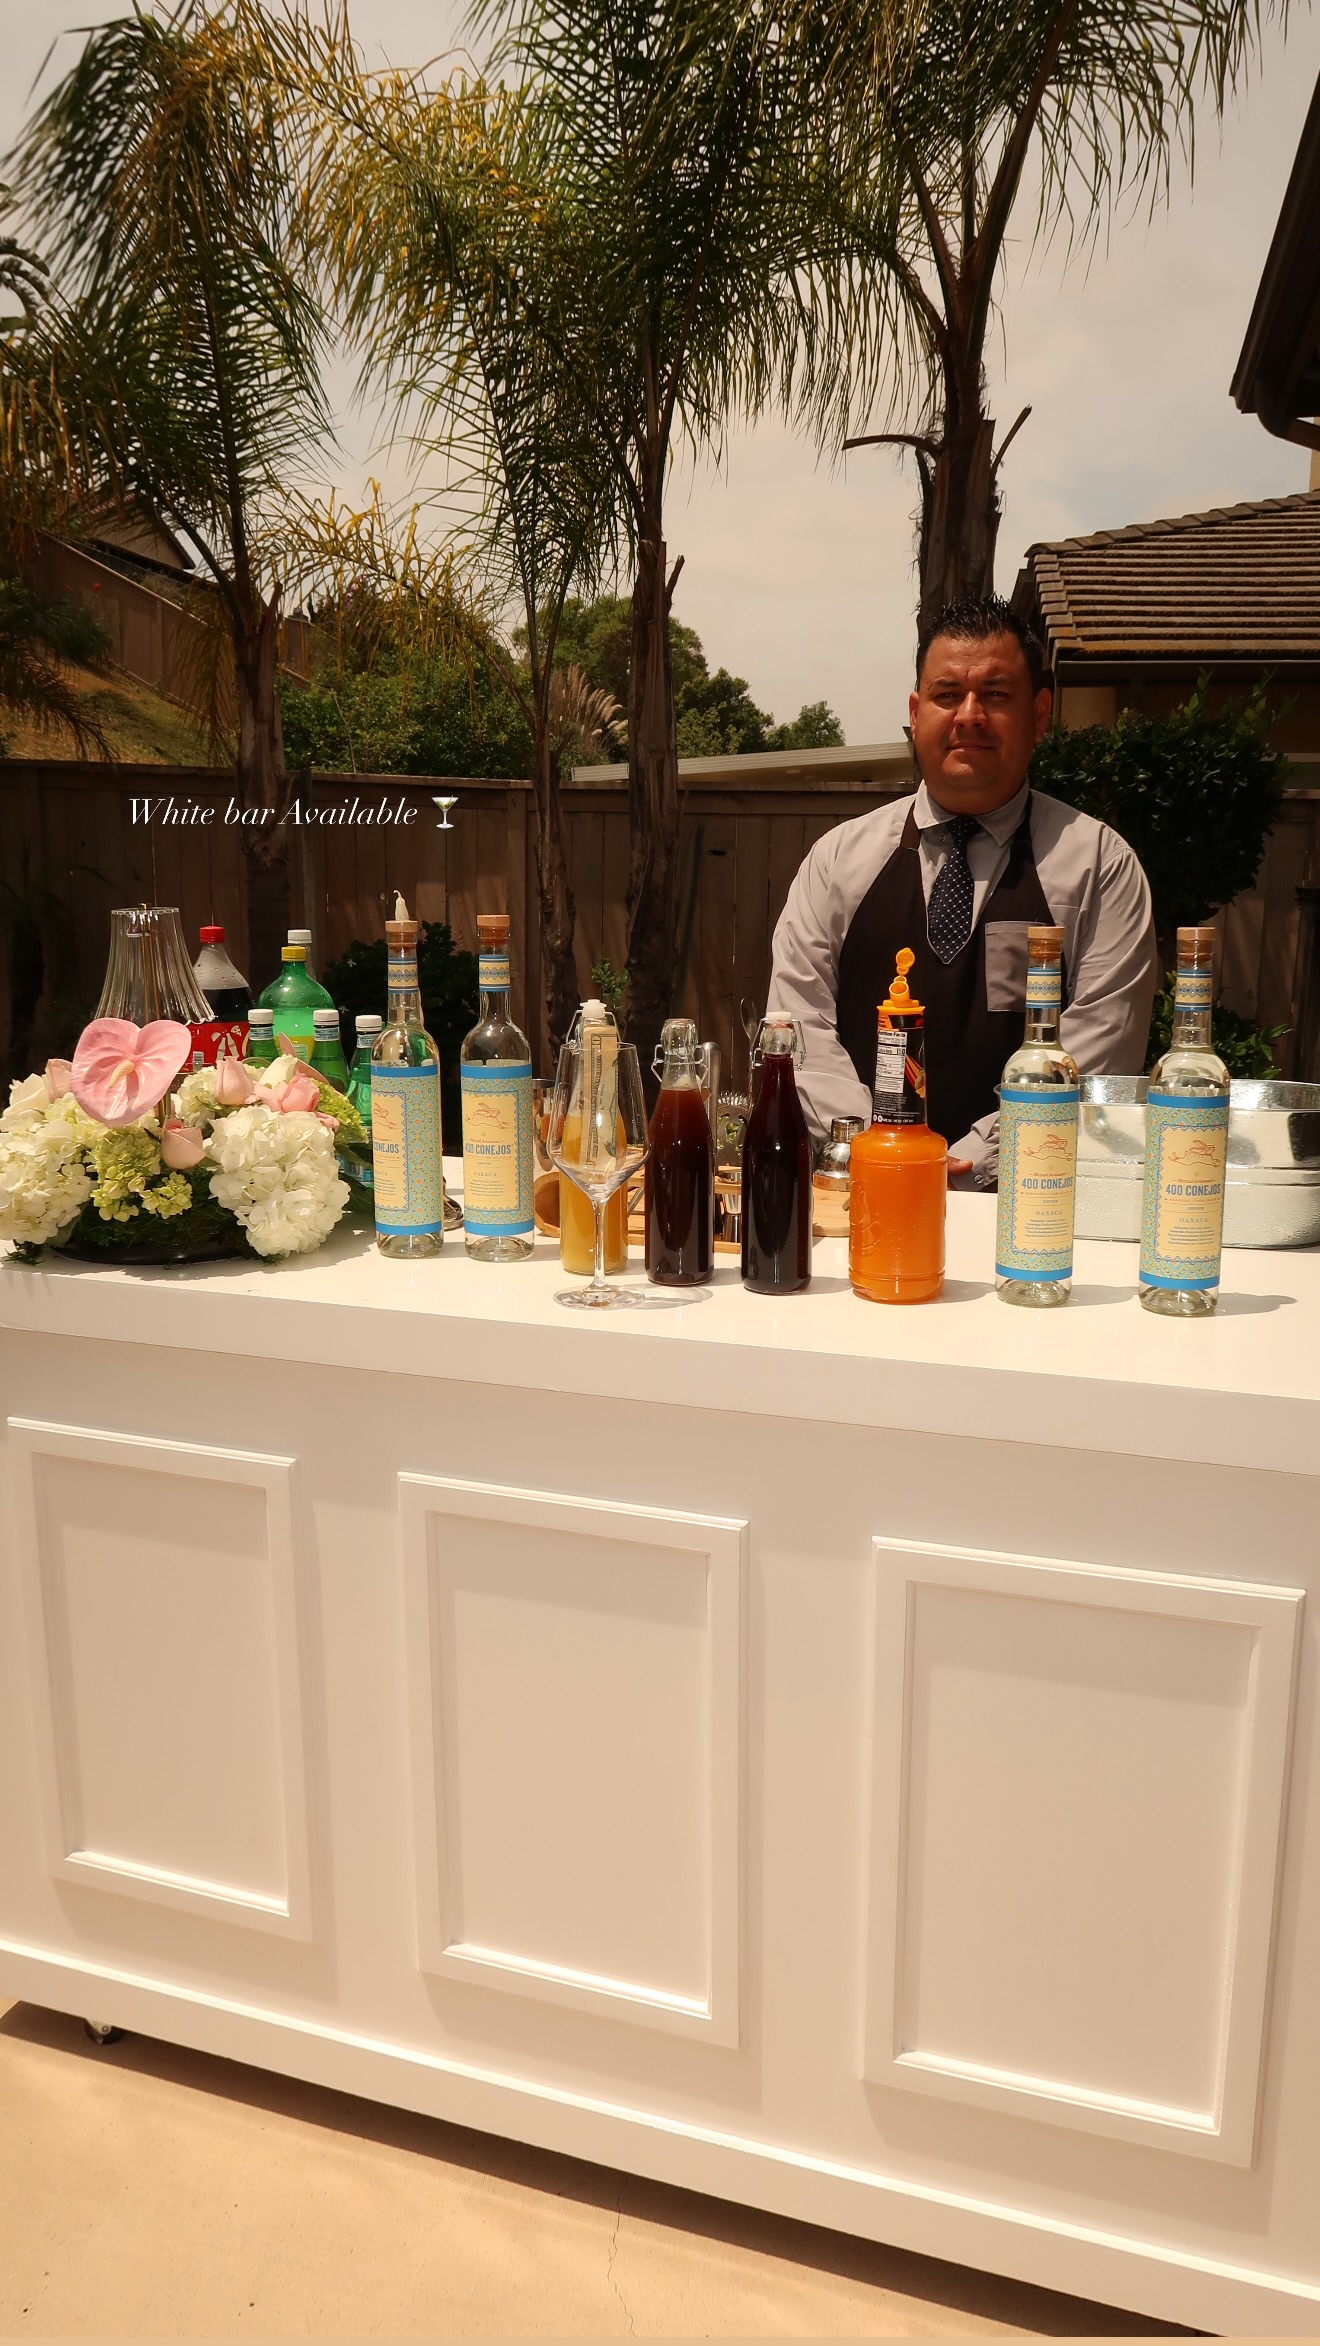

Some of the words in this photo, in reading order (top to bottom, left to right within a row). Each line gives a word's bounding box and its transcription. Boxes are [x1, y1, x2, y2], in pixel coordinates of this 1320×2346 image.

[475, 1144, 512, 1155] CONEJOS
[1021, 1178, 1038, 1190] 400
[1041, 1176, 1074, 1190] CONEJOS
[1165, 1184, 1183, 1196] 400
[1185, 1183, 1221, 1197] CONEJOS
